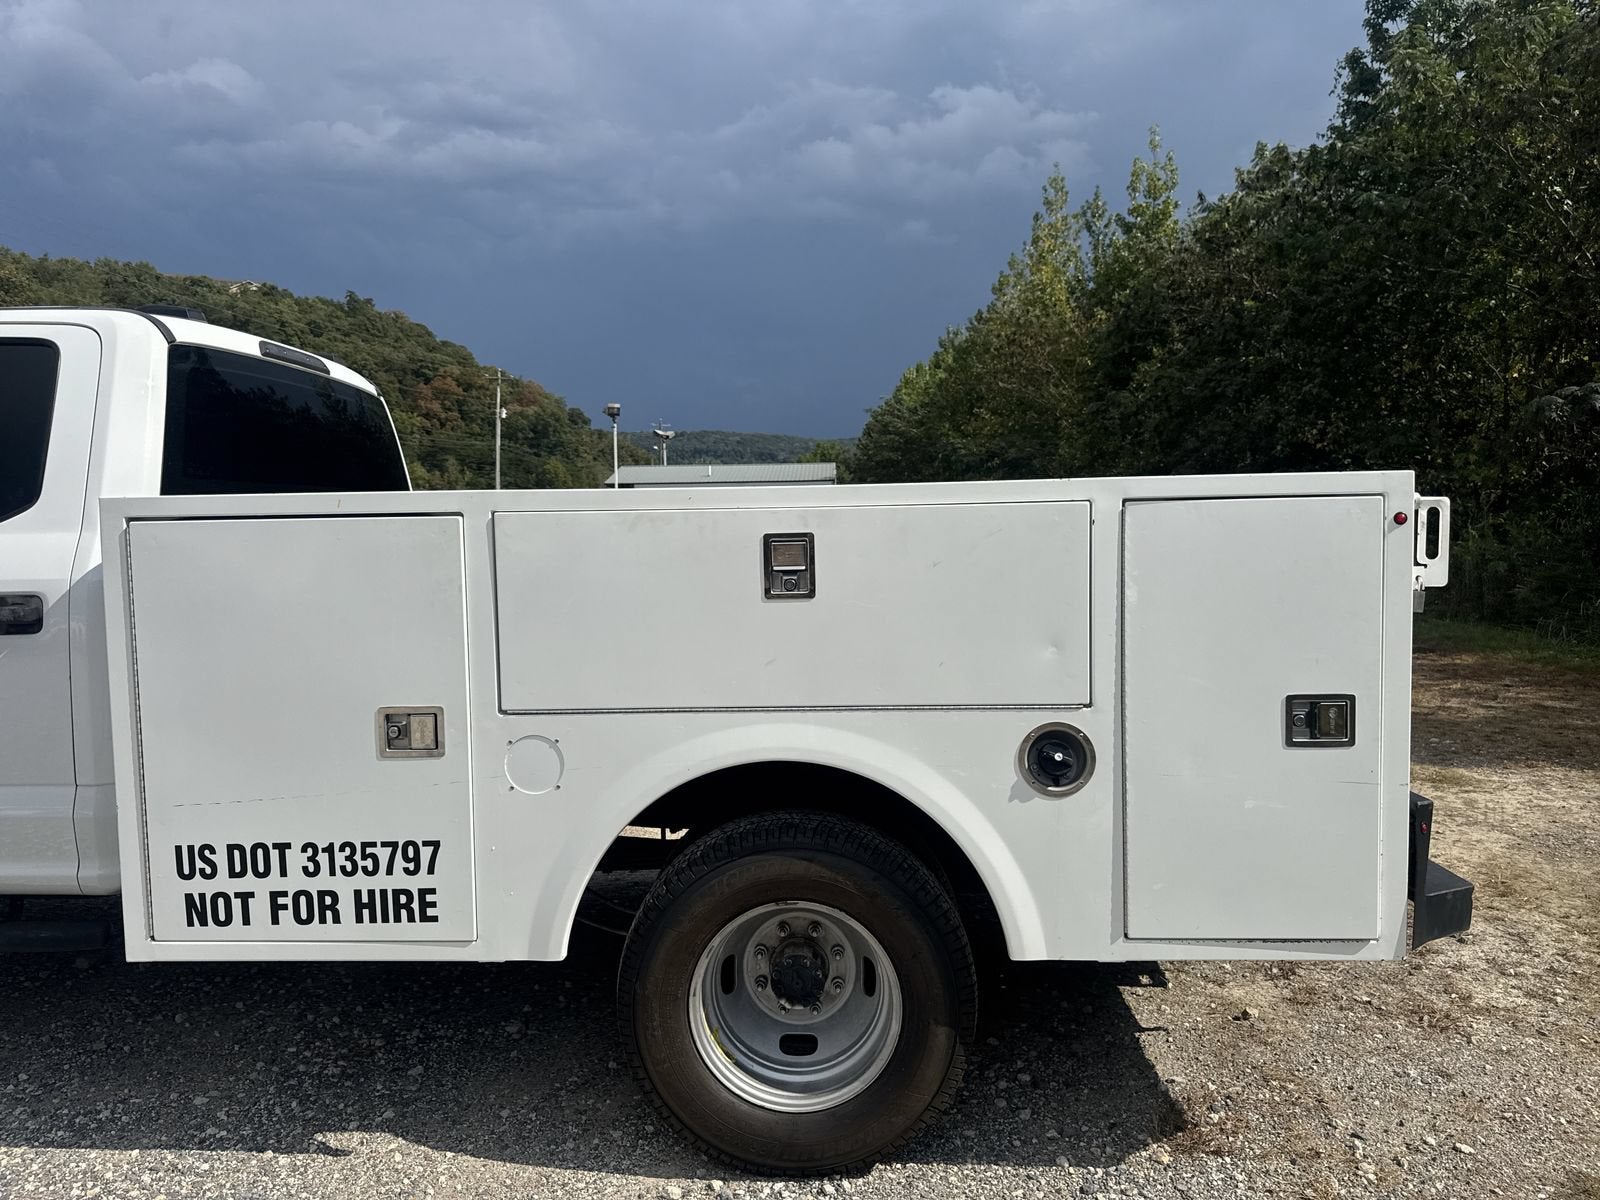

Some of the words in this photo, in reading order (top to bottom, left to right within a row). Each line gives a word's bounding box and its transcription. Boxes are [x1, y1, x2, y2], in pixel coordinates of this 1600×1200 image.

[174, 843, 218, 881] US
[225, 841, 292, 880] DOT
[300, 839, 441, 879] 3135797
[184, 890, 256, 928] NOT
[268, 889, 342, 926] FOR
[353, 887, 439, 925] HIRE
